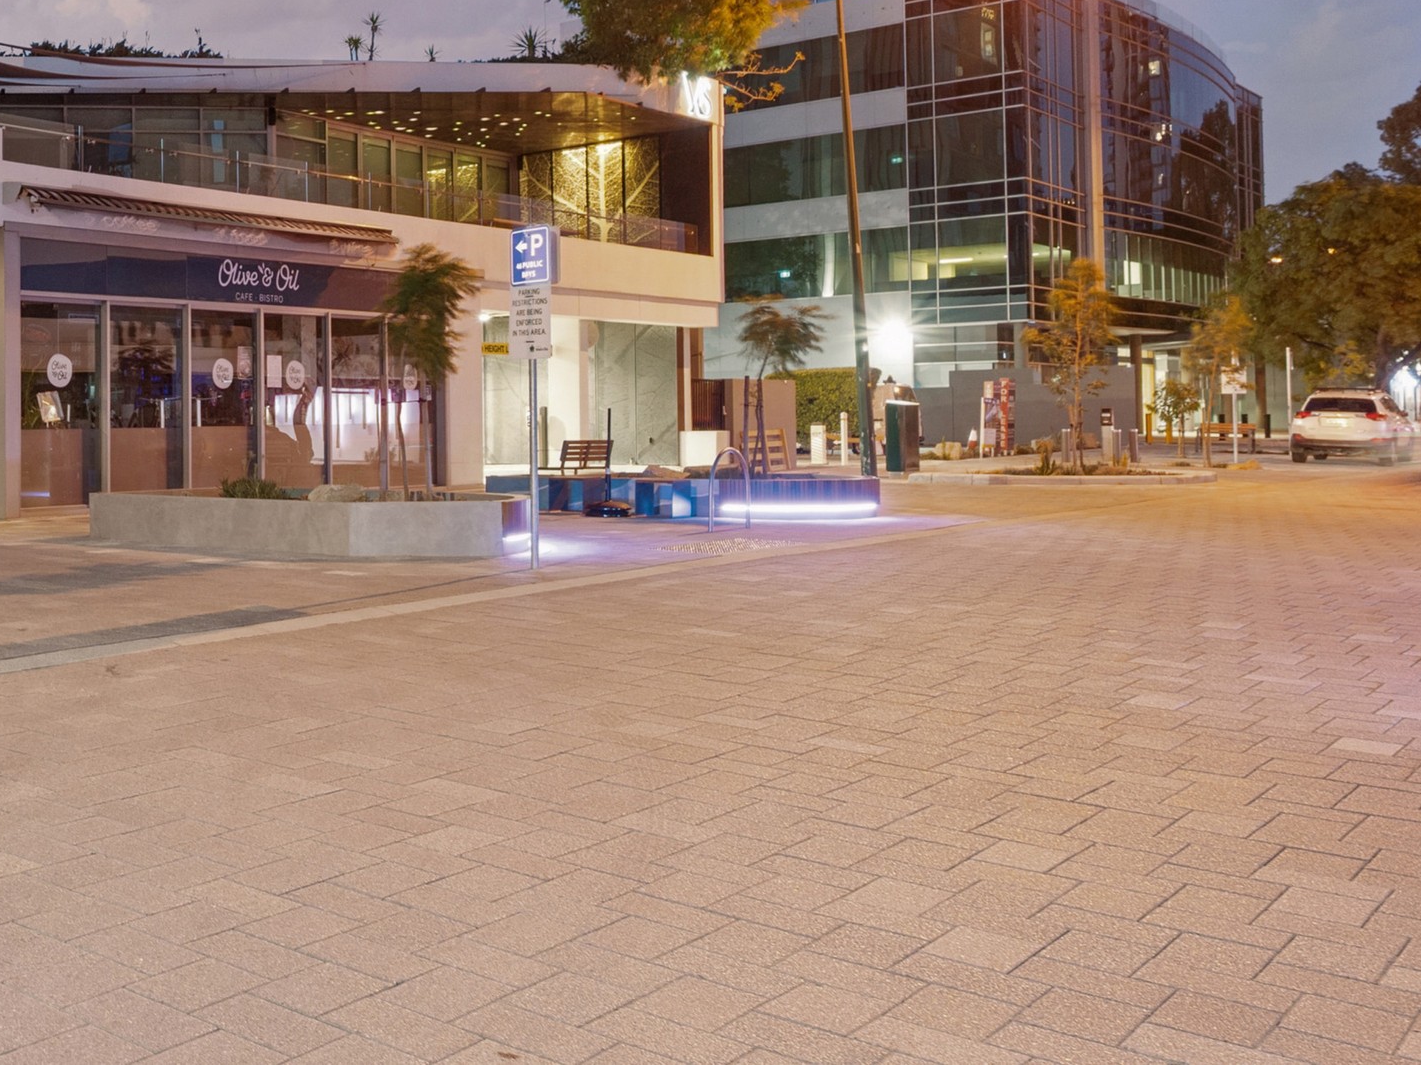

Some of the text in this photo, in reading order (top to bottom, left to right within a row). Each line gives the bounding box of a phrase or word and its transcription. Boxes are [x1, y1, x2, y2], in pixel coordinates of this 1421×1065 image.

[530, 233, 544, 257] P
[522, 259, 544, 269] PUBLIC
[218, 259, 259, 287] Olive
[276, 264, 300, 291] Oil
[518, 288, 541, 296] PARKING
[235, 292, 284, 304] CAFE BISTRO
[512, 297, 548, 307] RESTRICTIONS
[526, 308, 543, 316] BEING
[516, 318, 543, 327] ENFORCED
[485, 344, 505, 353] HEIGHT
